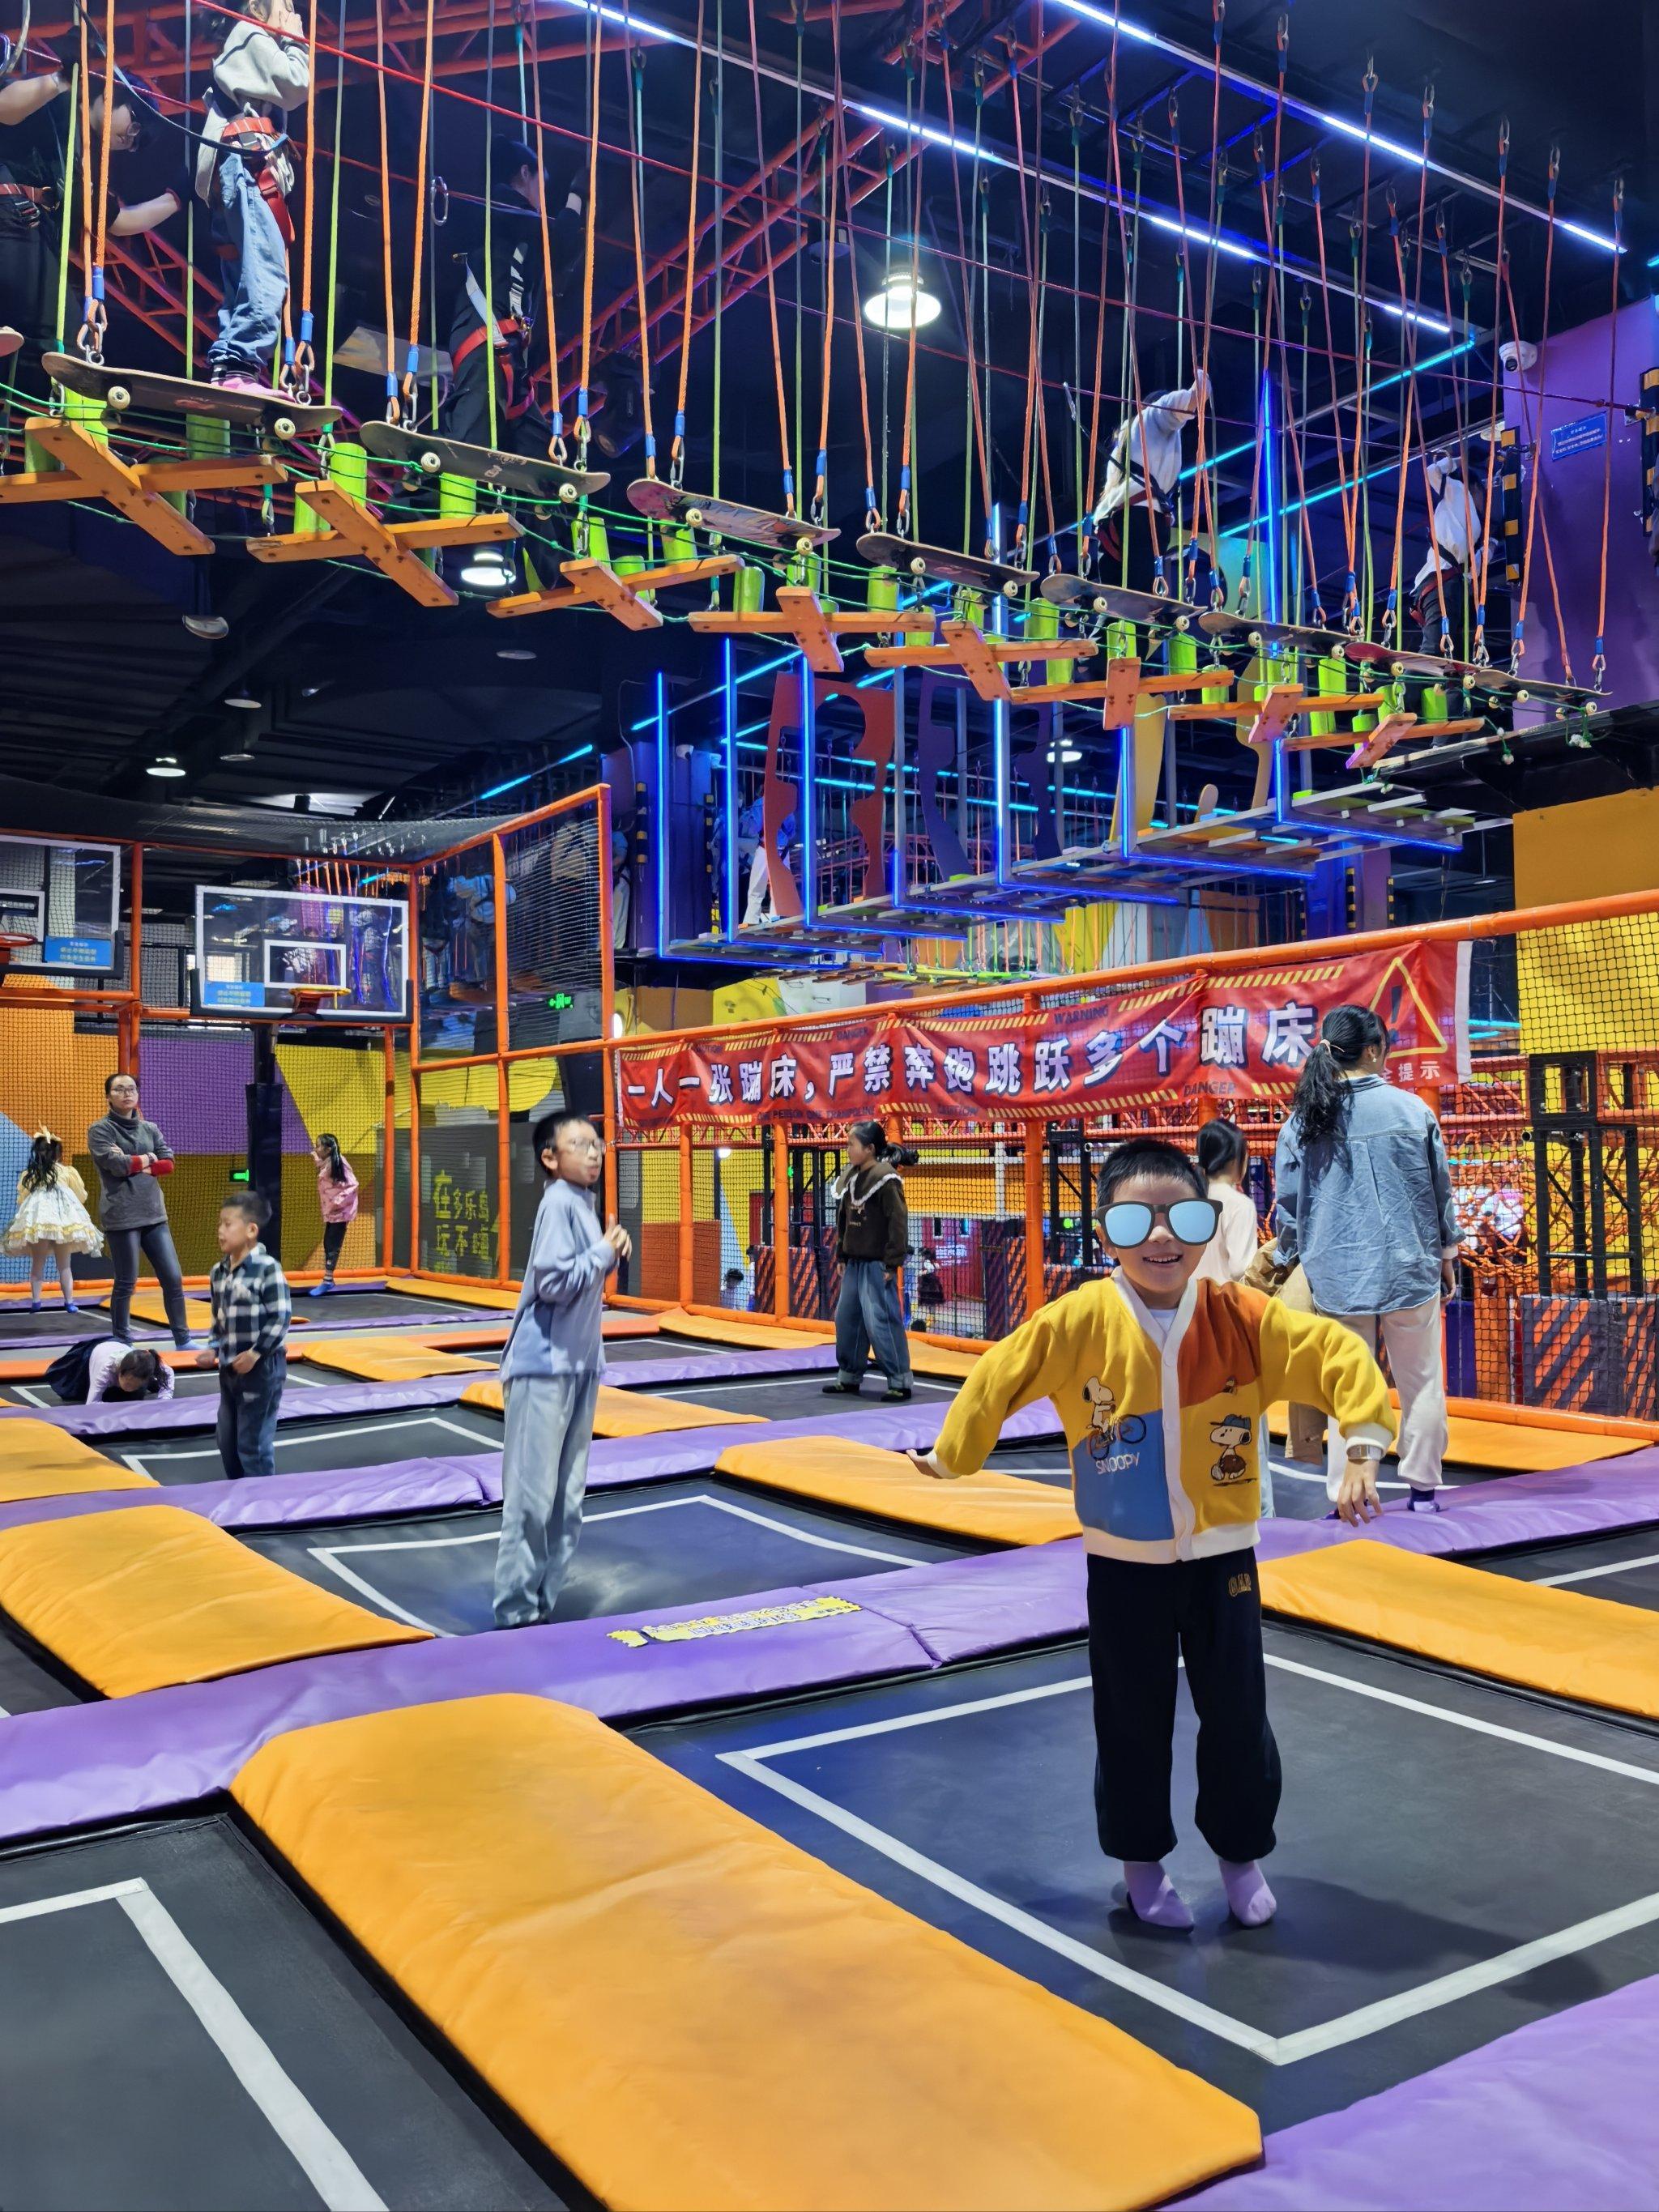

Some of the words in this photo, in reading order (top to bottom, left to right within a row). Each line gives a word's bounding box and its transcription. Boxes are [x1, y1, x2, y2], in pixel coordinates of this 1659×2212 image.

[1055, 1004, 1109, 1025] WARNING
[1183, 1081, 1237, 1097] DANGER
[1095, 1451, 1141, 1475] SNOOPY
